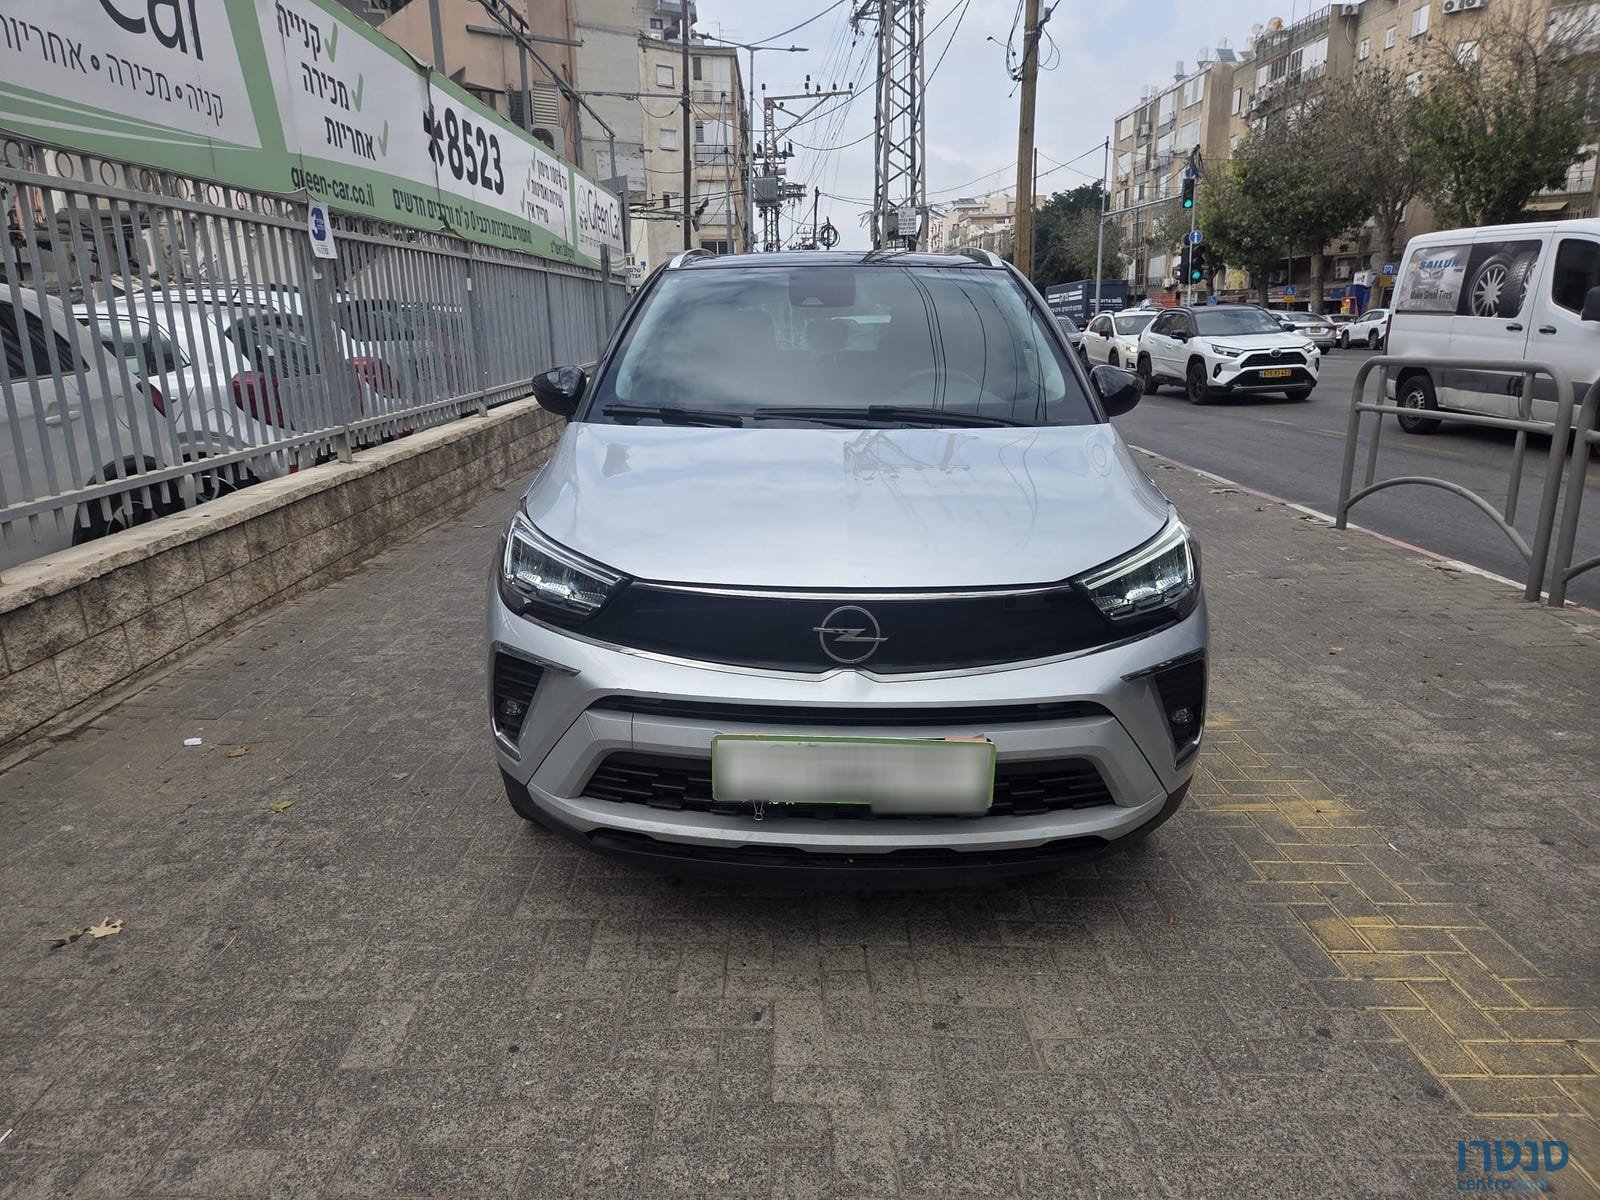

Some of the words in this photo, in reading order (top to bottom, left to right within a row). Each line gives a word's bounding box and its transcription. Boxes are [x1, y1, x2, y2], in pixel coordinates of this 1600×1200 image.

[275, 3, 321, 62] קניית
[106, 53, 171, 102] מכירה
[301, 62, 350, 111] מכירה
[186, 84, 224, 126] קניה
[324, 116, 376, 161] אחריות
[392, 188, 426, 218] חדשים
